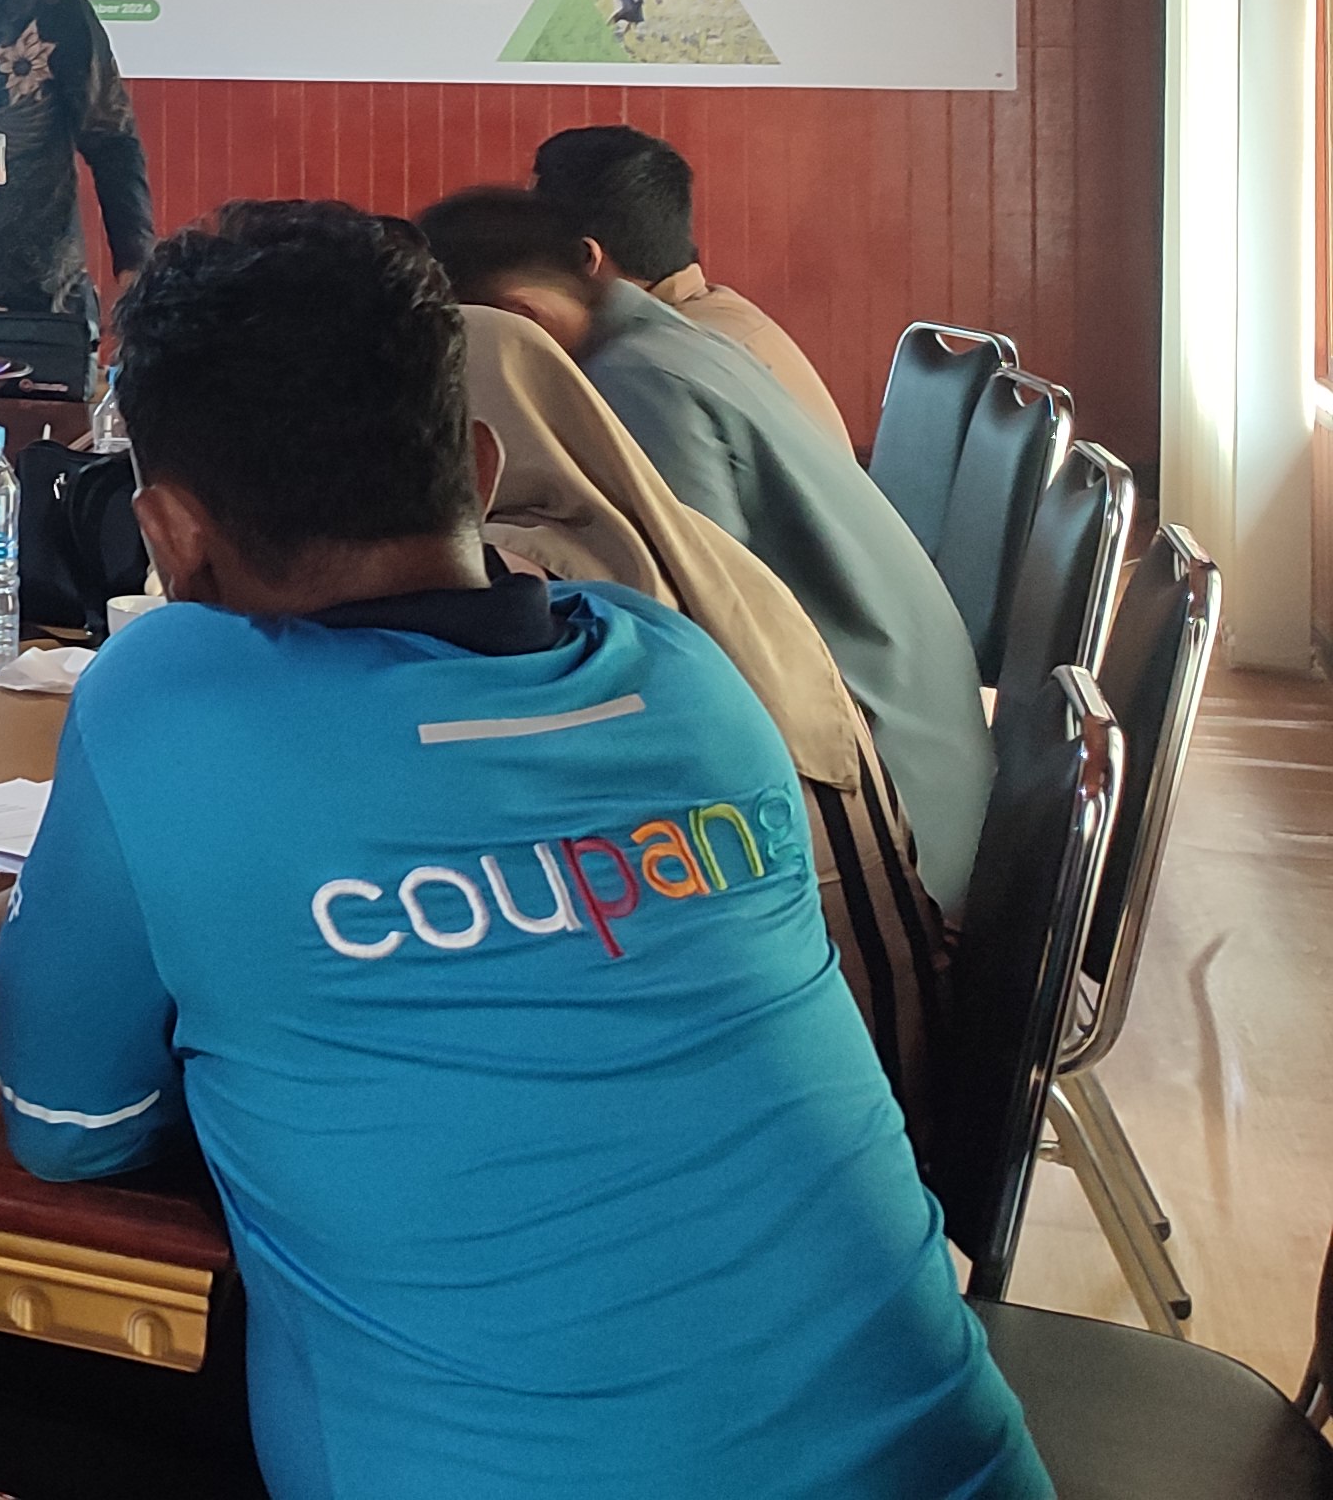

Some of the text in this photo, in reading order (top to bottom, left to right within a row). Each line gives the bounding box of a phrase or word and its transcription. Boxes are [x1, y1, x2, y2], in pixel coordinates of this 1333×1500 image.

[94, 3, 152, 14] ber 2024
[312, 784, 809, 959] coupang
